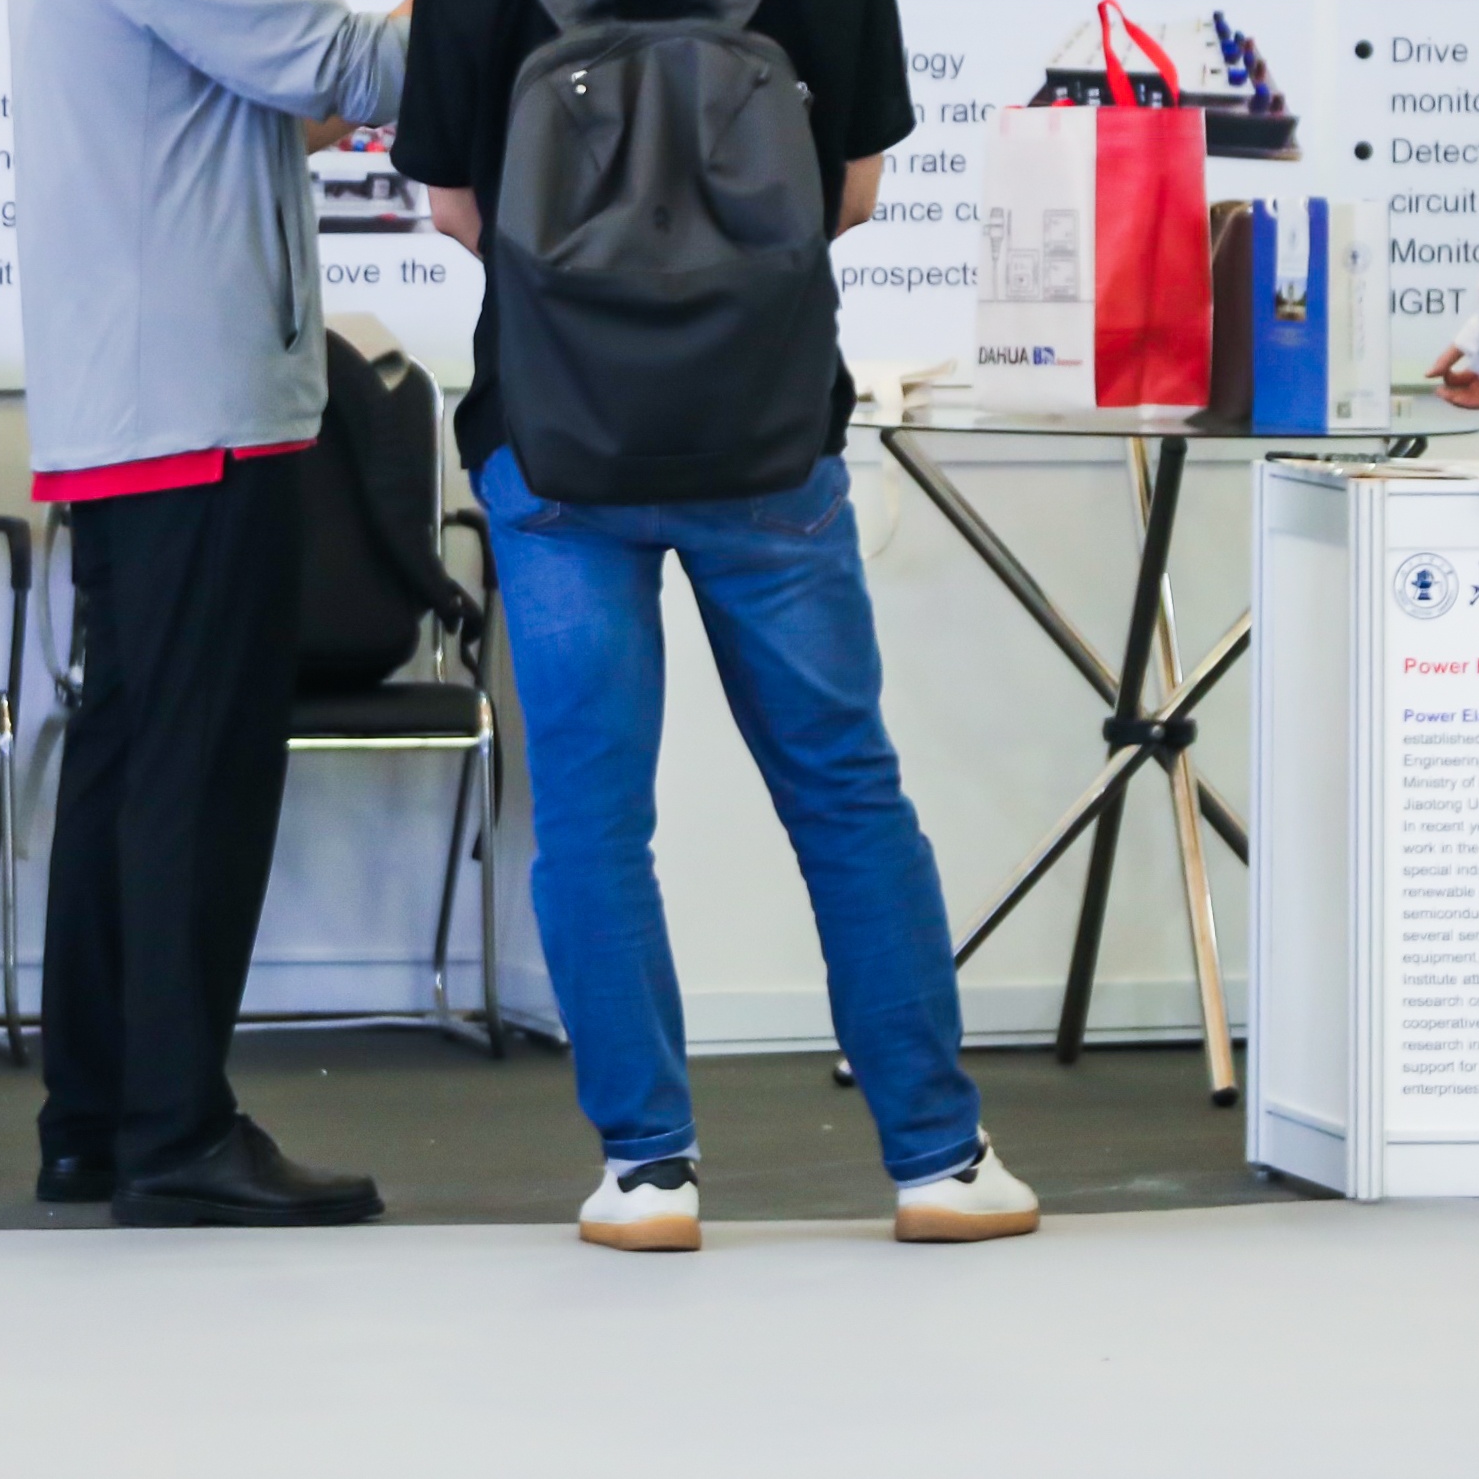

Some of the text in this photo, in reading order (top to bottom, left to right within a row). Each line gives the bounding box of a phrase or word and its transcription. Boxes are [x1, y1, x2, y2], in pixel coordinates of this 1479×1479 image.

[1392, 37, 1470, 65] Drive
[910, 151, 967, 175] rate
[1390, 191, 1478, 216] circuit
[1390, 288, 1467, 317] IGBT
[979, 347, 1031, 367] DAHUA
[1404, 657, 1471, 677] Power
[1403, 708, 1458, 725] Power
